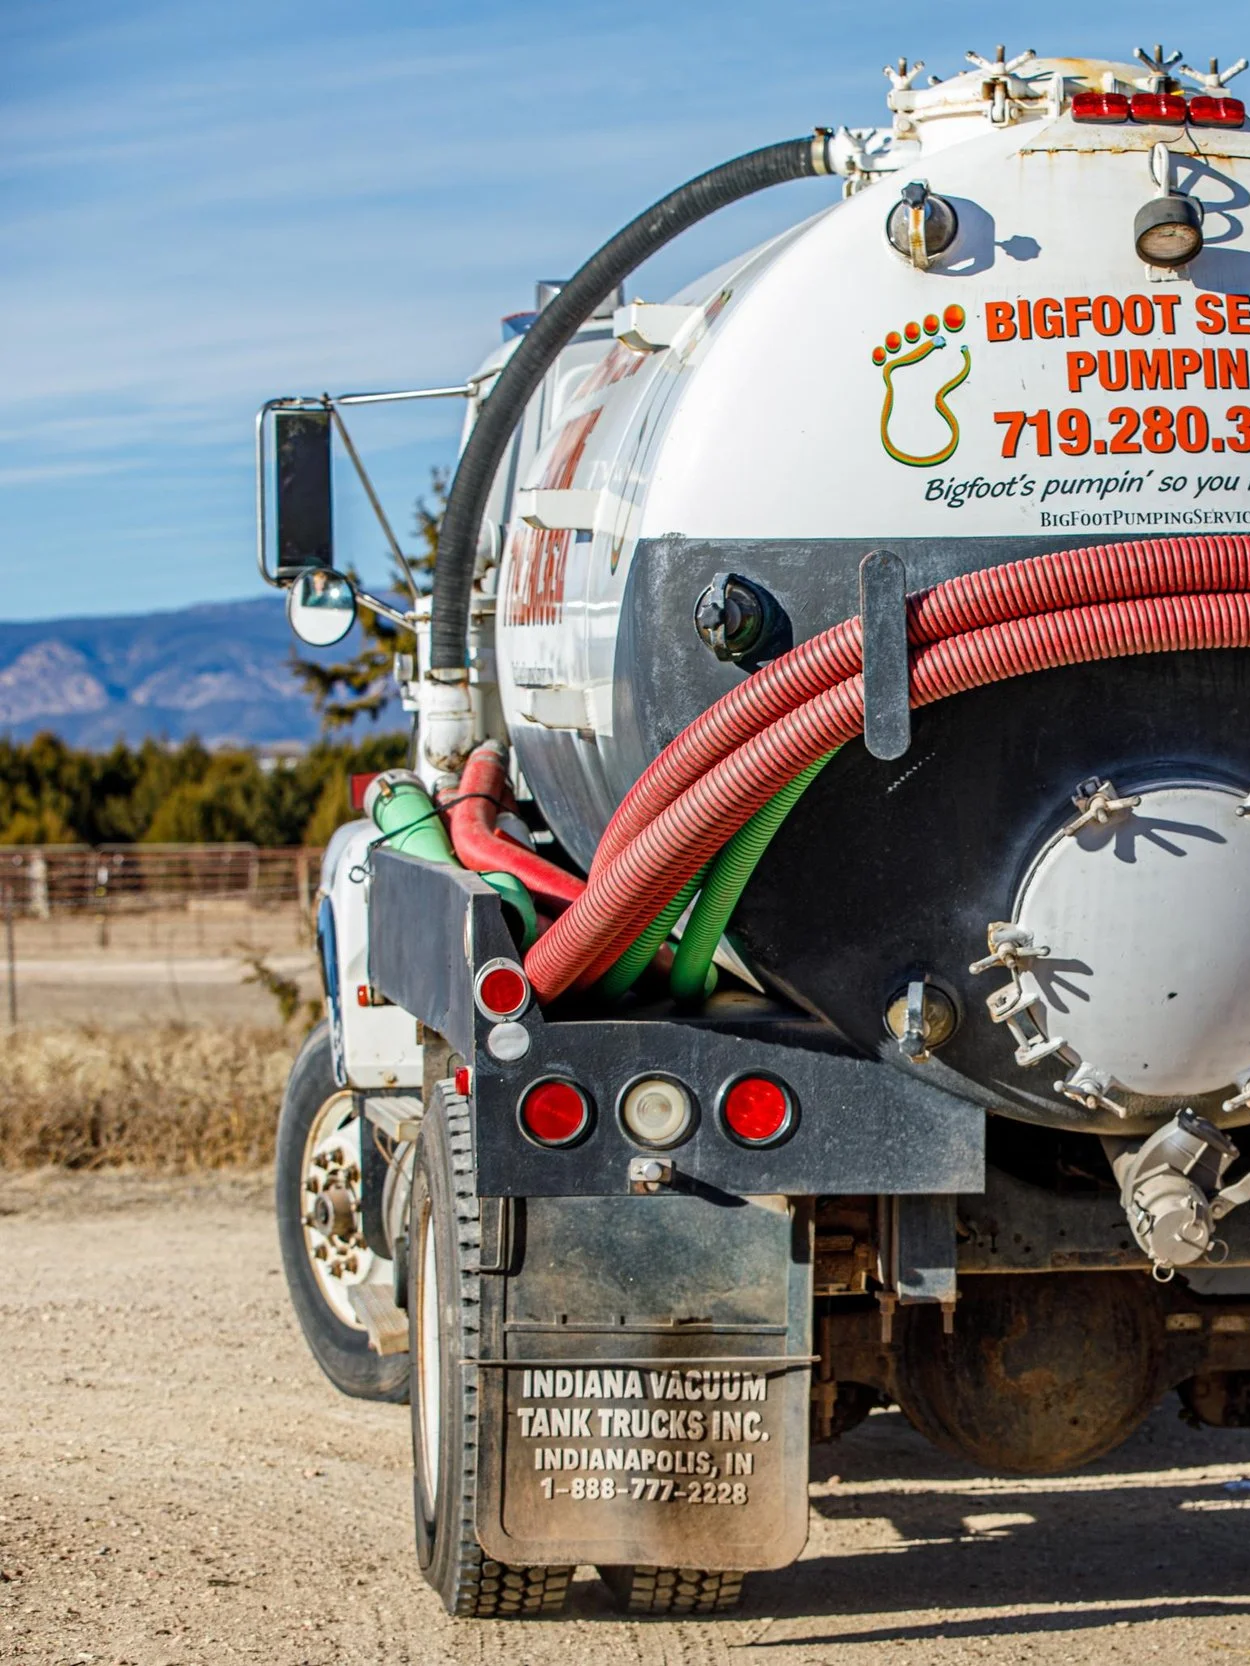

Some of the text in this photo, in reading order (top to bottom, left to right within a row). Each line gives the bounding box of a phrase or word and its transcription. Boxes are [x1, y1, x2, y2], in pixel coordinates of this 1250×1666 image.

[985, 294, 1181, 342] BIGFOOT
[1158, 476, 1187, 492] so
[1194, 474, 1240, 498] you
[523, 1370, 767, 1401] INDIANA VACUUM
[517, 1408, 770, 1442] TANK TRUCKS INC.
[534, 1448, 753, 1478] INDIANAPOLIS, IN
